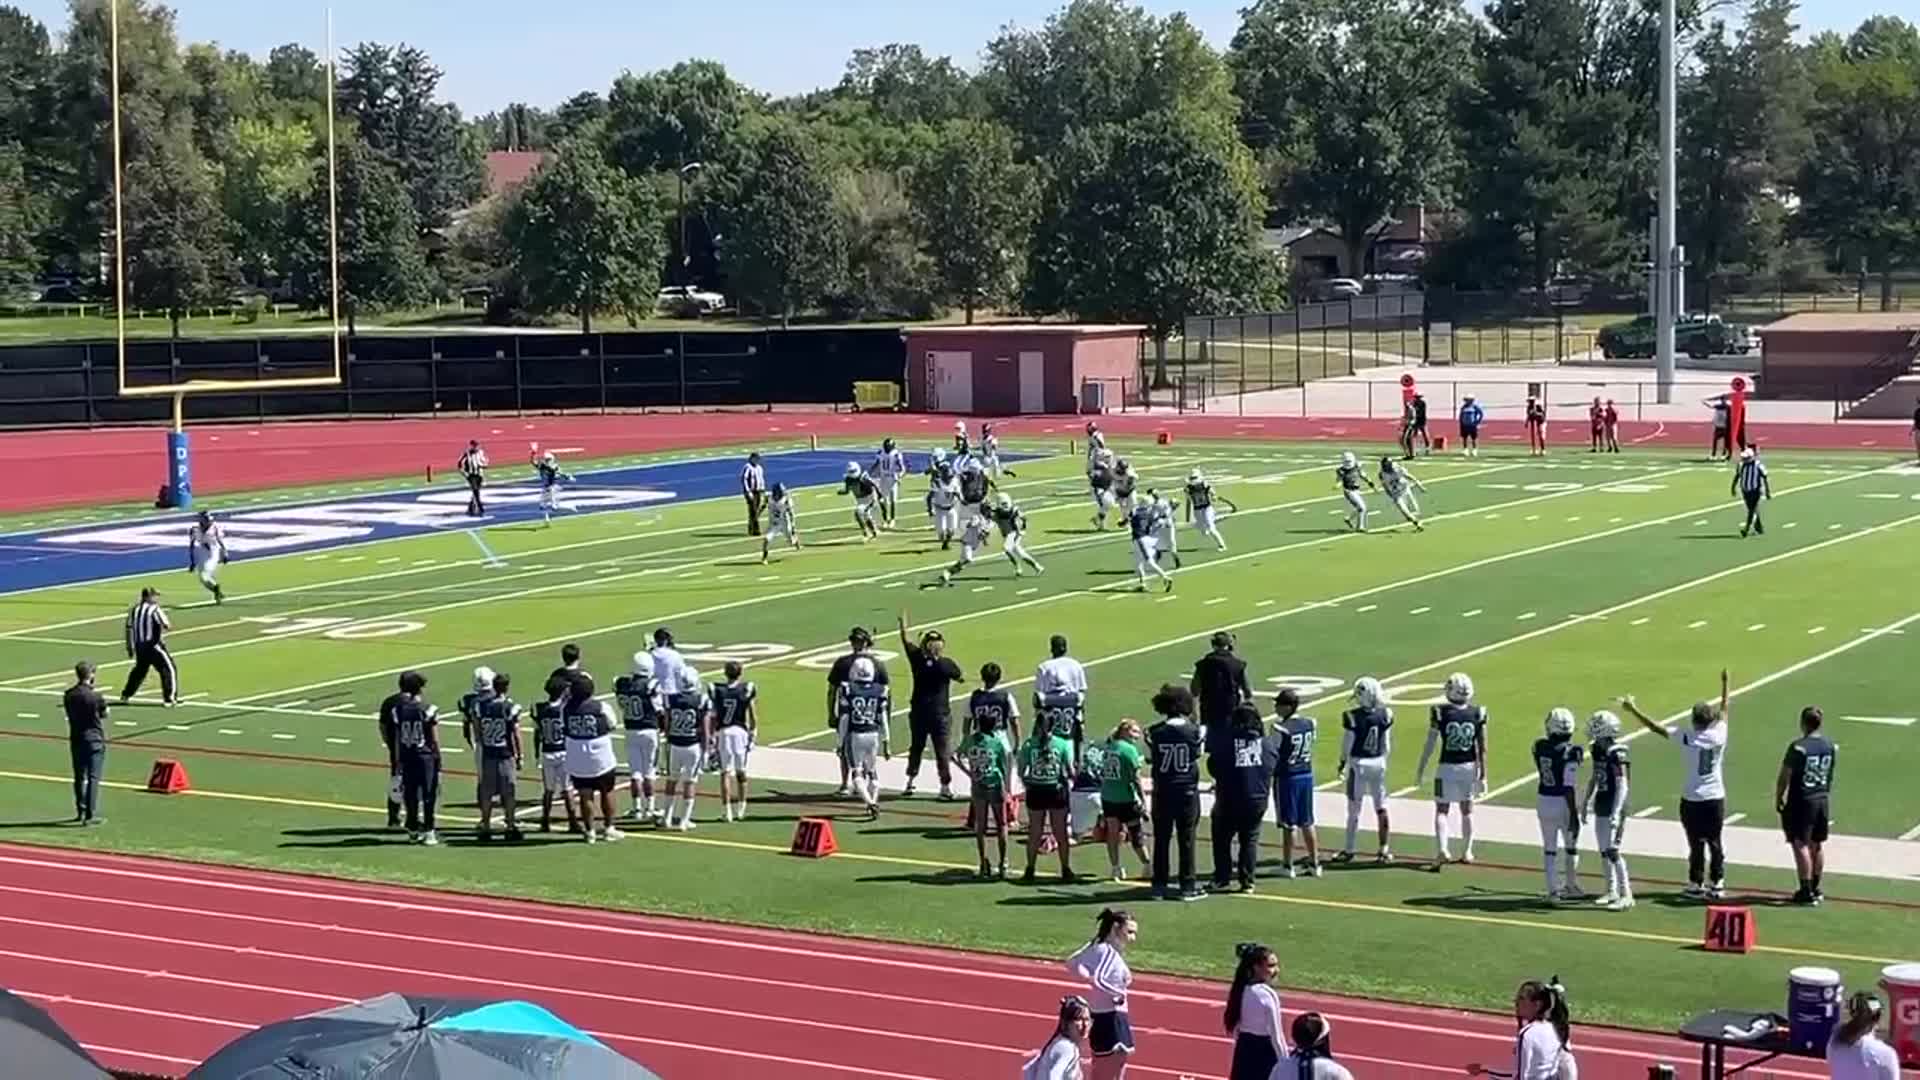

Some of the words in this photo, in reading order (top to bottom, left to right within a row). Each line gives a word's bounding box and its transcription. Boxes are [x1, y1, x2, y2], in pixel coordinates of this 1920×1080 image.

[723, 698, 738, 725] 7
[1363, 725, 1379, 755] 4
[1158, 743, 1190, 773] 70
[149, 761, 176, 790] 20
[794, 821, 823, 852] 30
[1708, 911, 1746, 950] 40
